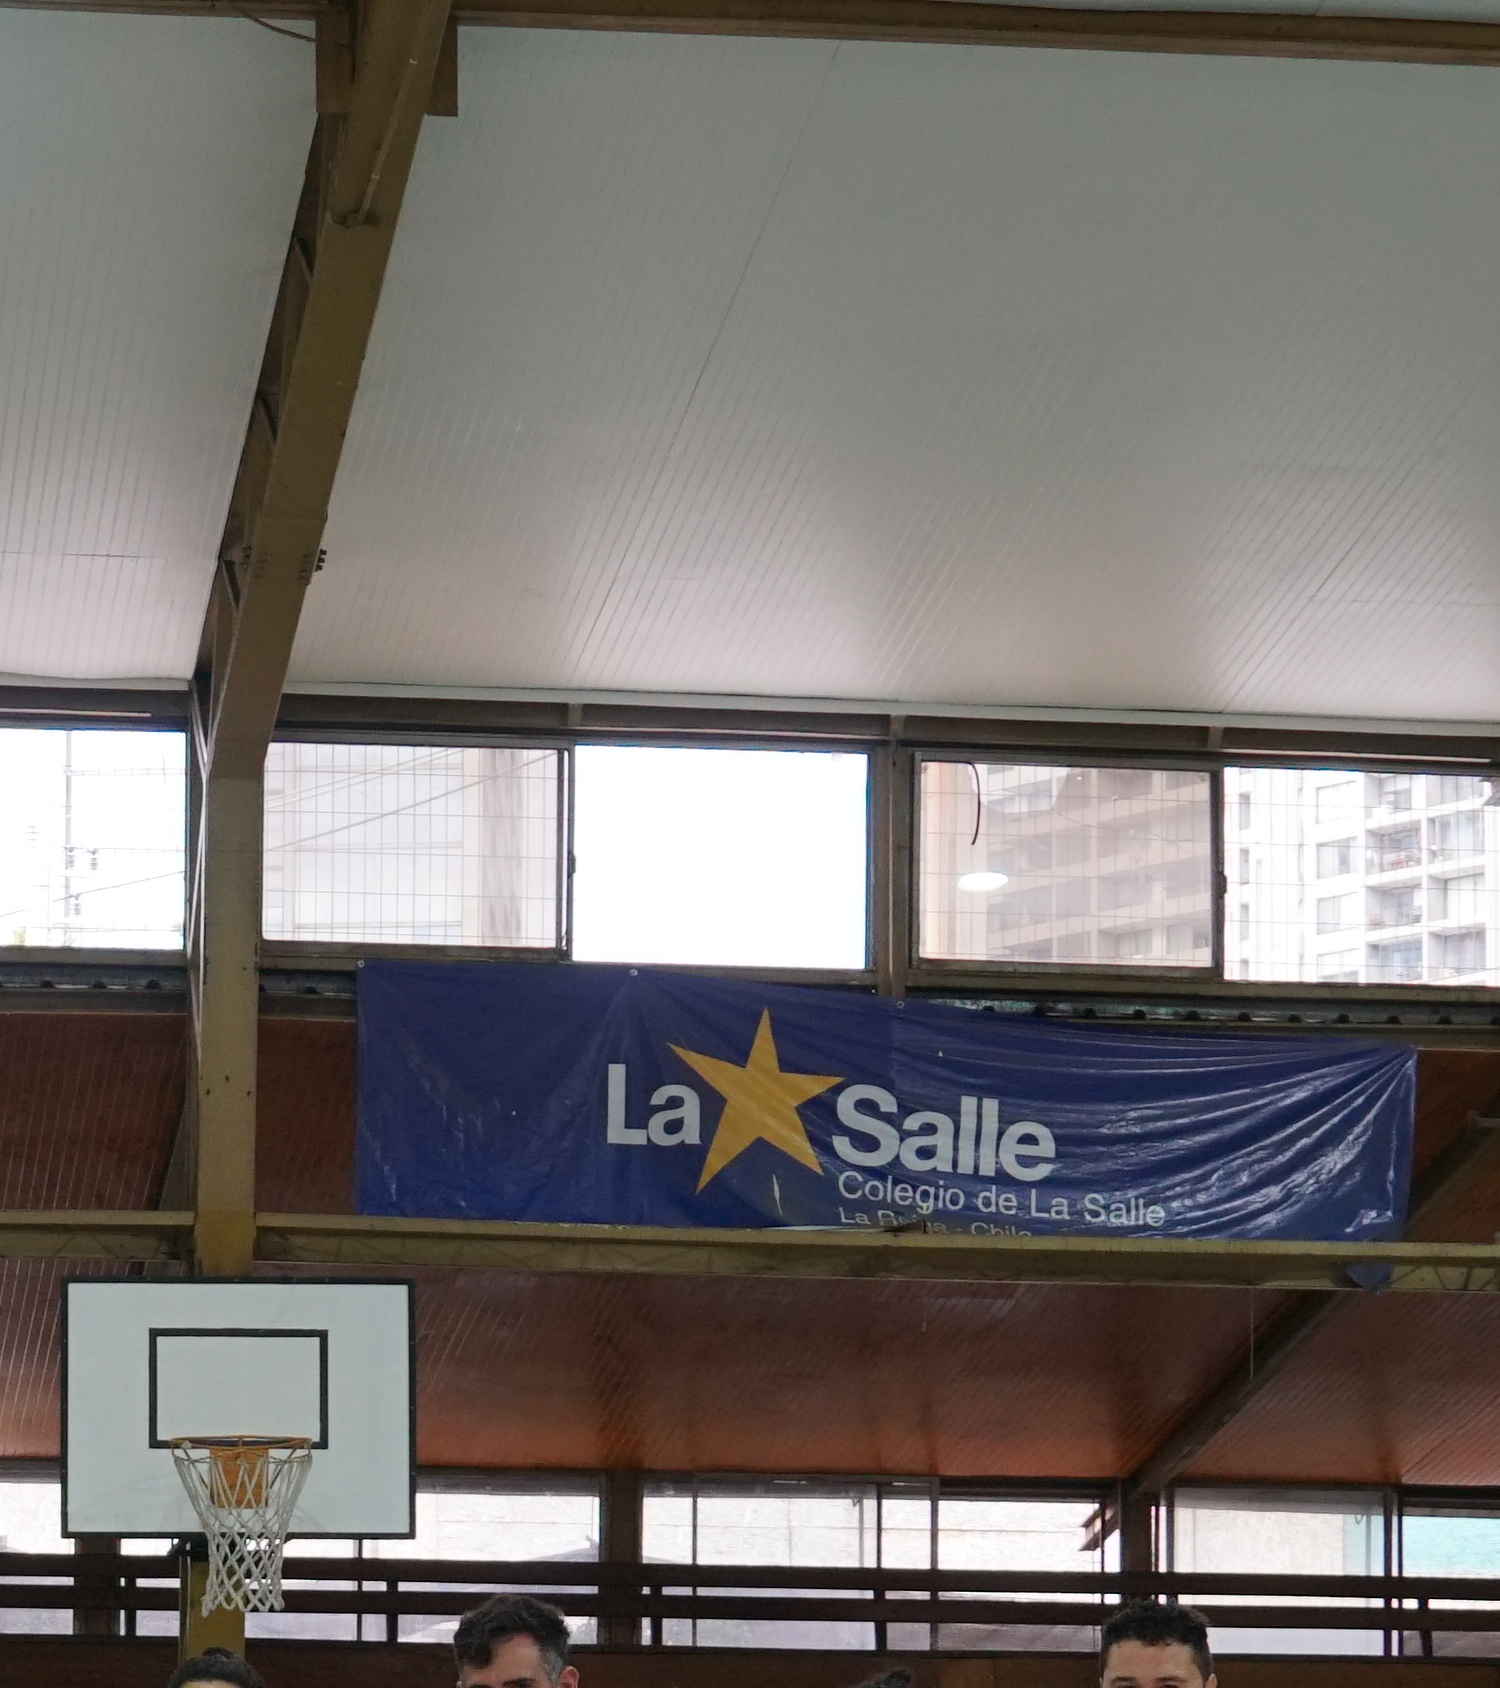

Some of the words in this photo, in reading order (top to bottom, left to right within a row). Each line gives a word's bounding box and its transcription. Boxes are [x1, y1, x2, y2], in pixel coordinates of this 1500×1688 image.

[607, 1063, 701, 1148] La
[831, 1083, 1056, 1182] Salle
[838, 1170, 966, 1215] Colegio
[977, 1185, 1018, 1215] de
[1031, 1188, 1070, 1220] La
[1084, 1193, 1166, 1228] Salle
[838, 1207, 871, 1226] La
